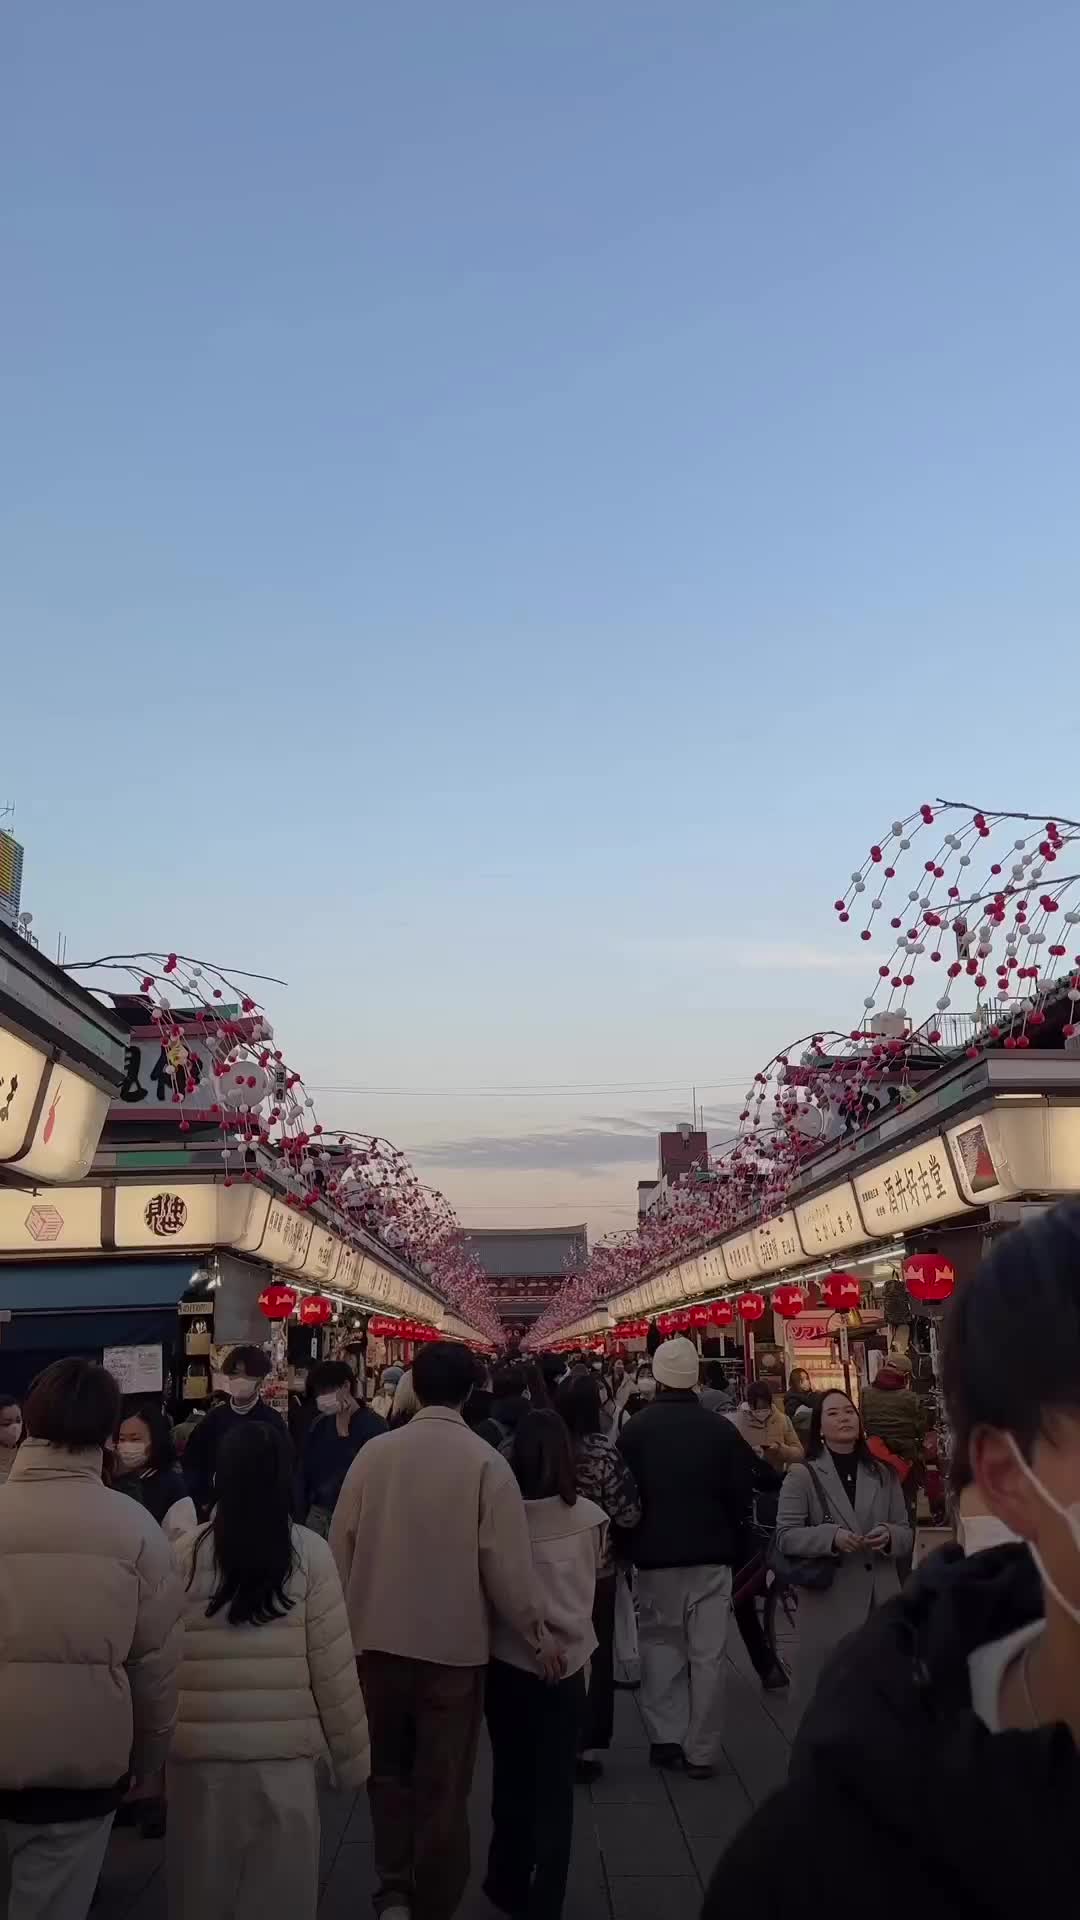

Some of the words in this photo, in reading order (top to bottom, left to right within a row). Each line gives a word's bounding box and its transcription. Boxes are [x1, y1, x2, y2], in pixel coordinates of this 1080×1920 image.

[884, 1154, 947, 1214] 酒井好古堂
